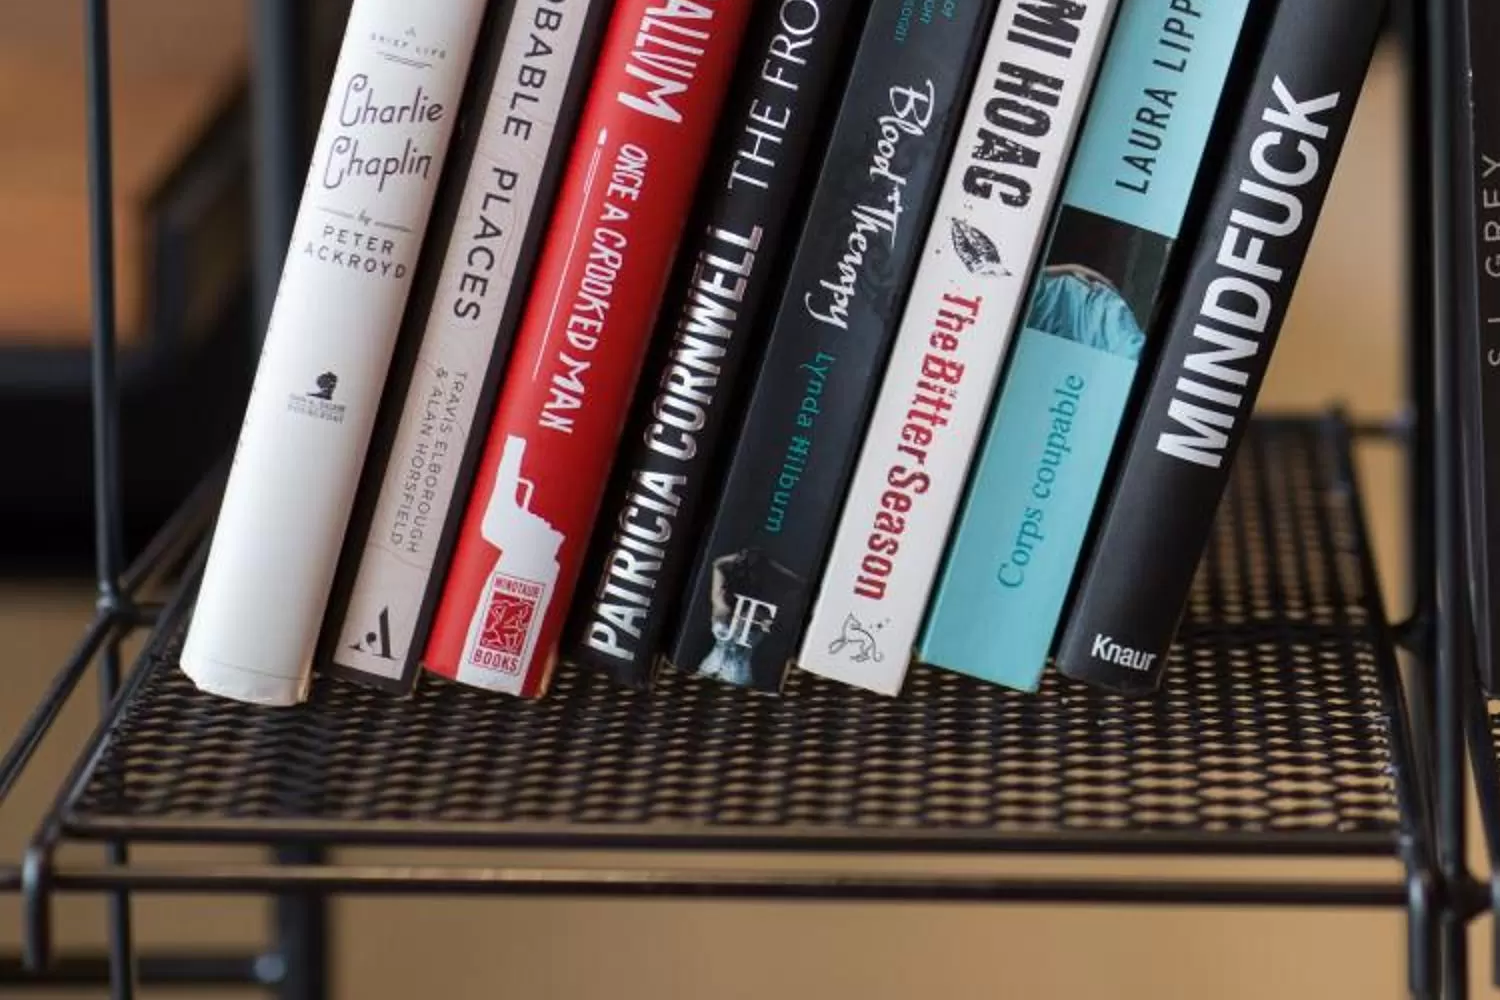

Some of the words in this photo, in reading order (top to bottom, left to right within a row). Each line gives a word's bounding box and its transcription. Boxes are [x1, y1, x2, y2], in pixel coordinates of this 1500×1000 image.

[340, 72, 444, 128] Charlie
[868, 79, 935, 186] Blood
[960, 61, 1066, 209] HOAG
[1115, 86, 1178, 196] LAURA
[323, 134, 432, 192] Chaplin
[600, 201, 630, 222] A
[606, 142, 649, 202] ONCE
[303, 240, 408, 280] ACKROYD
[322, 224, 396, 256] PETER
[453, 165, 520, 323] PLACES
[565, 226, 628, 352] CROOKED
[805, 185, 908, 331] Therapy
[1155, 74, 1342, 469] MINDFUCK
[928, 292, 985, 355] The
[418, 383, 443, 438] ALAN
[440, 369, 469, 434] TRAVIS
[538, 351, 592, 434] MAN
[586, 468, 688, 661] PATRICIA
[642, 222, 764, 463] CORNWELL
[727, 97, 791, 191] THE
[794, 350, 838, 428] Lynda
[897, 352, 966, 467] Bitter
[390, 441, 426, 547] HORSFIELD
[404, 439, 449, 554] ELBOROUGH
[764, 434, 814, 535] Hilburn
[853, 463, 932, 601] Season
[997, 504, 1046, 590] Corps
[1029, 373, 1087, 501] coupable
[474, 648, 519, 673] BOOKS
[1090, 632, 1159, 673] Knaur
